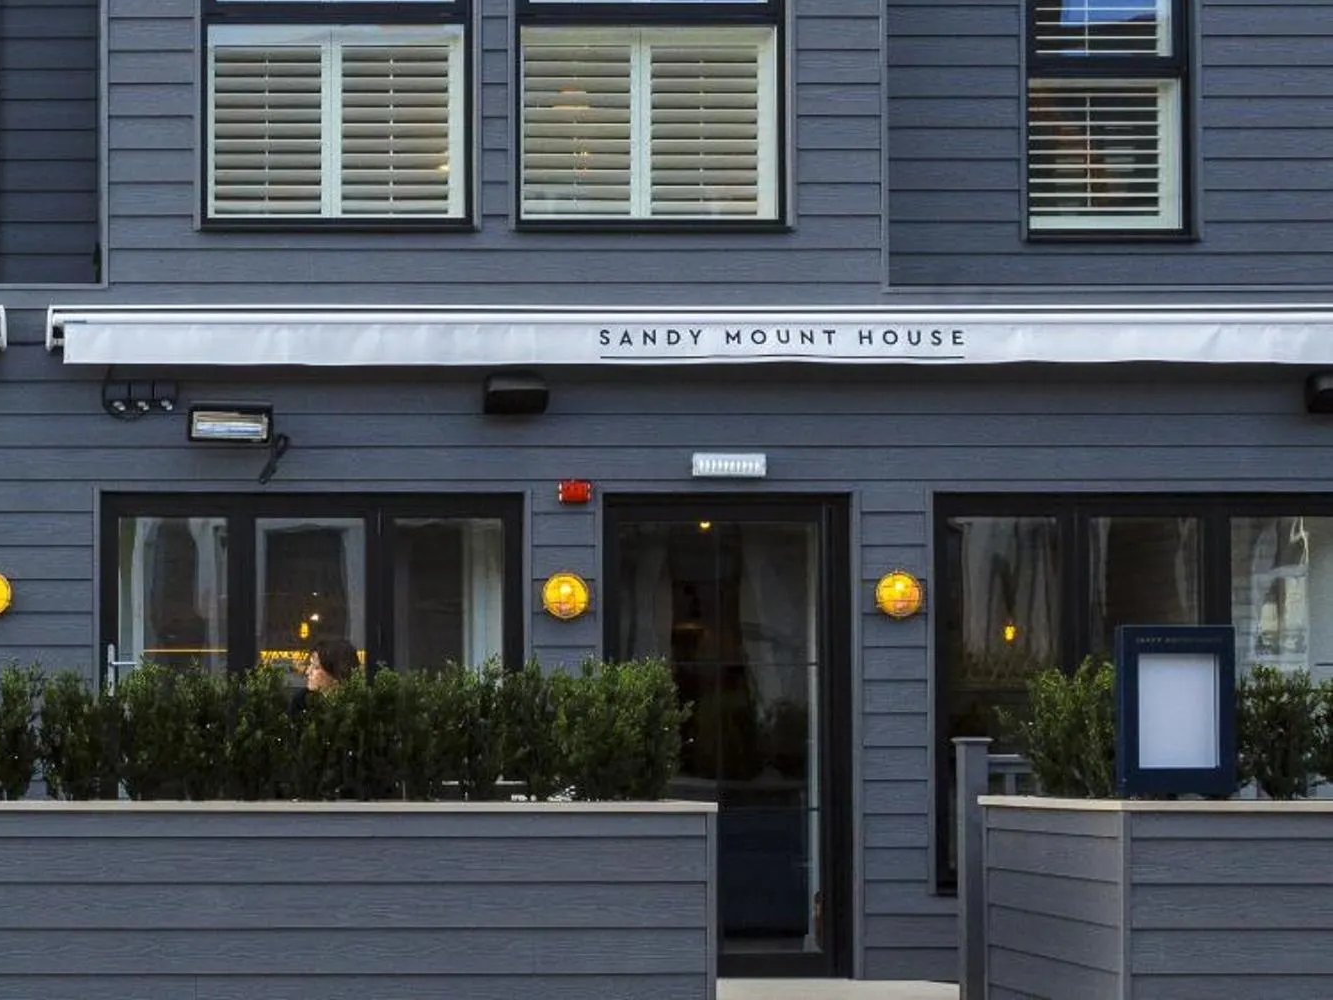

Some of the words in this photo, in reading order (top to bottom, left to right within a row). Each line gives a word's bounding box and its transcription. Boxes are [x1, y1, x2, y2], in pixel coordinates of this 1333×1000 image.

[599, 329, 703, 346] SANDY
[724, 329, 837, 346] MOUNT
[858, 329, 965, 346] HOUSE
